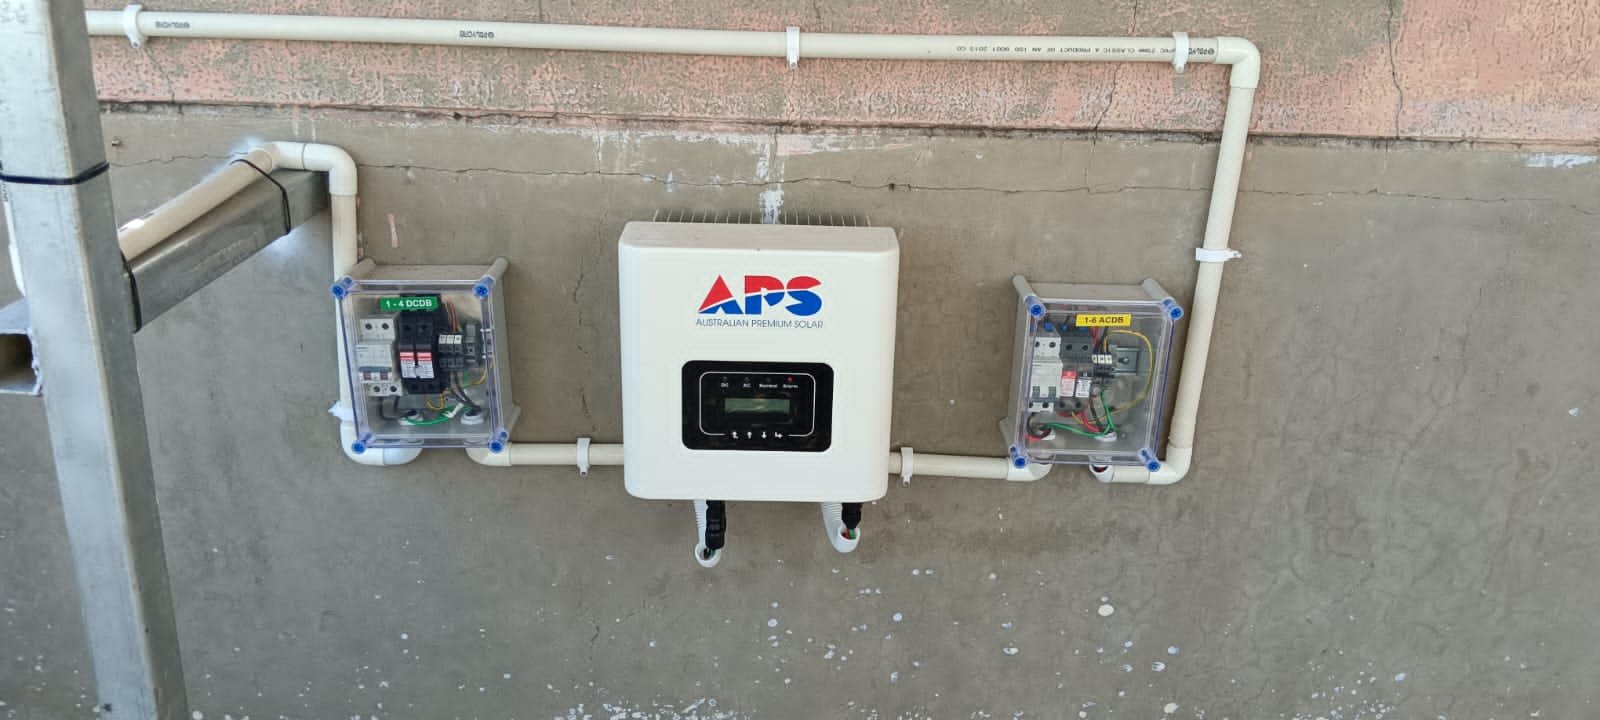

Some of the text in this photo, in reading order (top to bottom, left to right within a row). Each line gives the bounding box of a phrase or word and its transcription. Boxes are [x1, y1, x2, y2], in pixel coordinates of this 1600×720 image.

[698, 274, 822, 316] APS
[386, 299, 391, 308] 1
[398, 299, 404, 308] 4
[406, 299, 432, 308] DCDB
[696, 318, 824, 329] AUSTRALIAN PREMIUM SOLAR
[1099, 316, 1124, 324] ACDB
